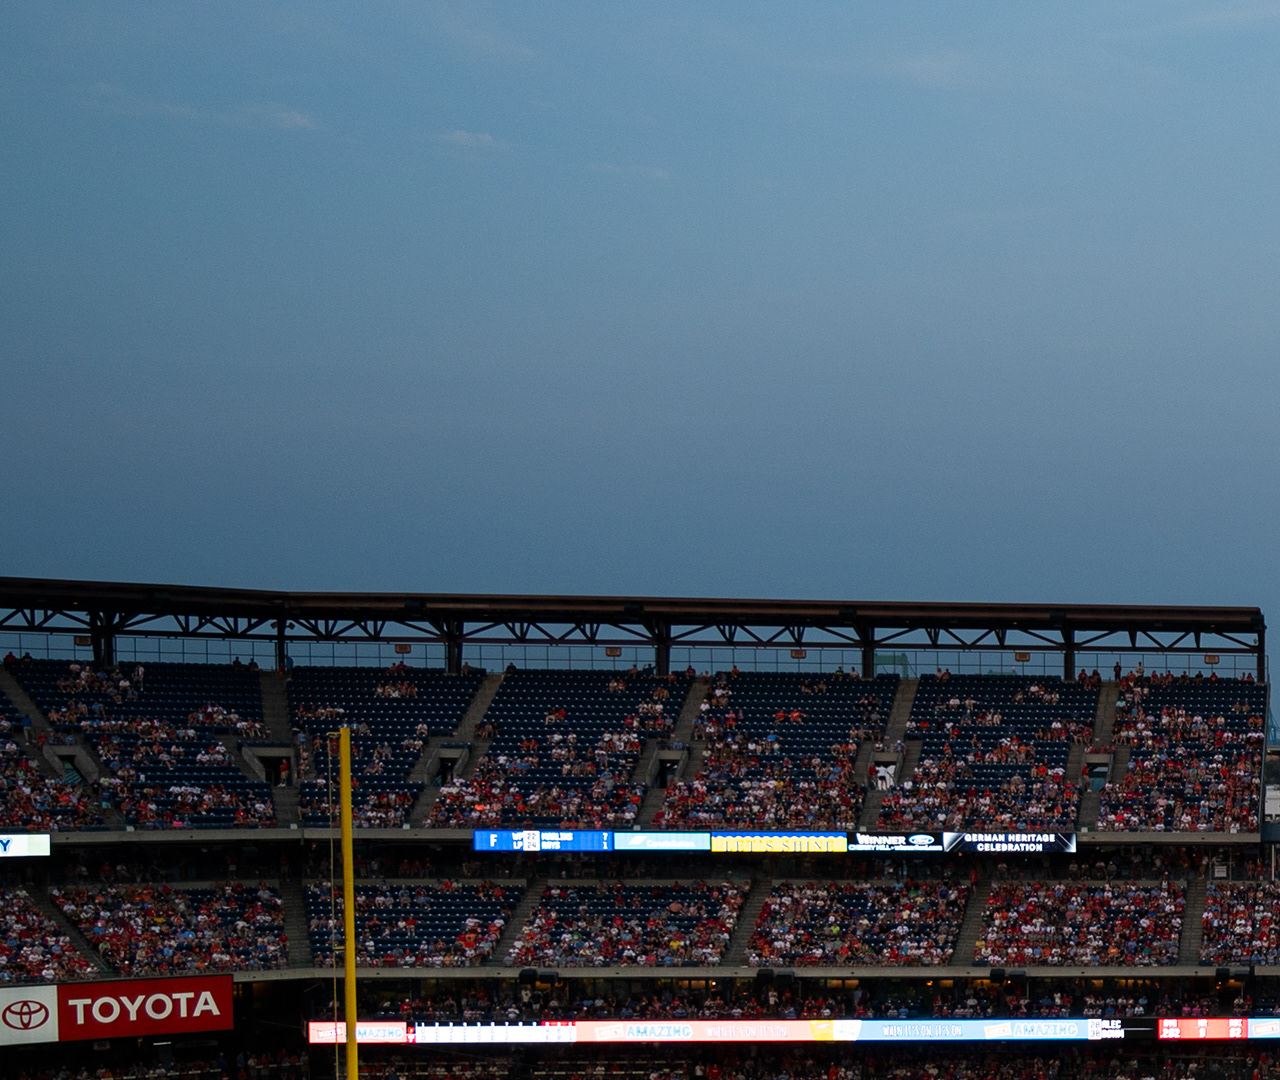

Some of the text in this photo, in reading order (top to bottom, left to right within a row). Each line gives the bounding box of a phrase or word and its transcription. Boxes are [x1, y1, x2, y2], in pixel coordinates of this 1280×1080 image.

[490, 834, 497, 846] F
[856, 833, 906, 845] WINNER
[964, 834, 1055, 842] GERMAN HERITAGE
[977, 844, 1043, 852] CELEBRATION
[68, 990, 221, 1026] TOYOTA
[356, 1027, 402, 1039] MAZING
[627, 1025, 691, 1038] AMAZING
[1013, 1023, 1078, 1037] AMAZING
